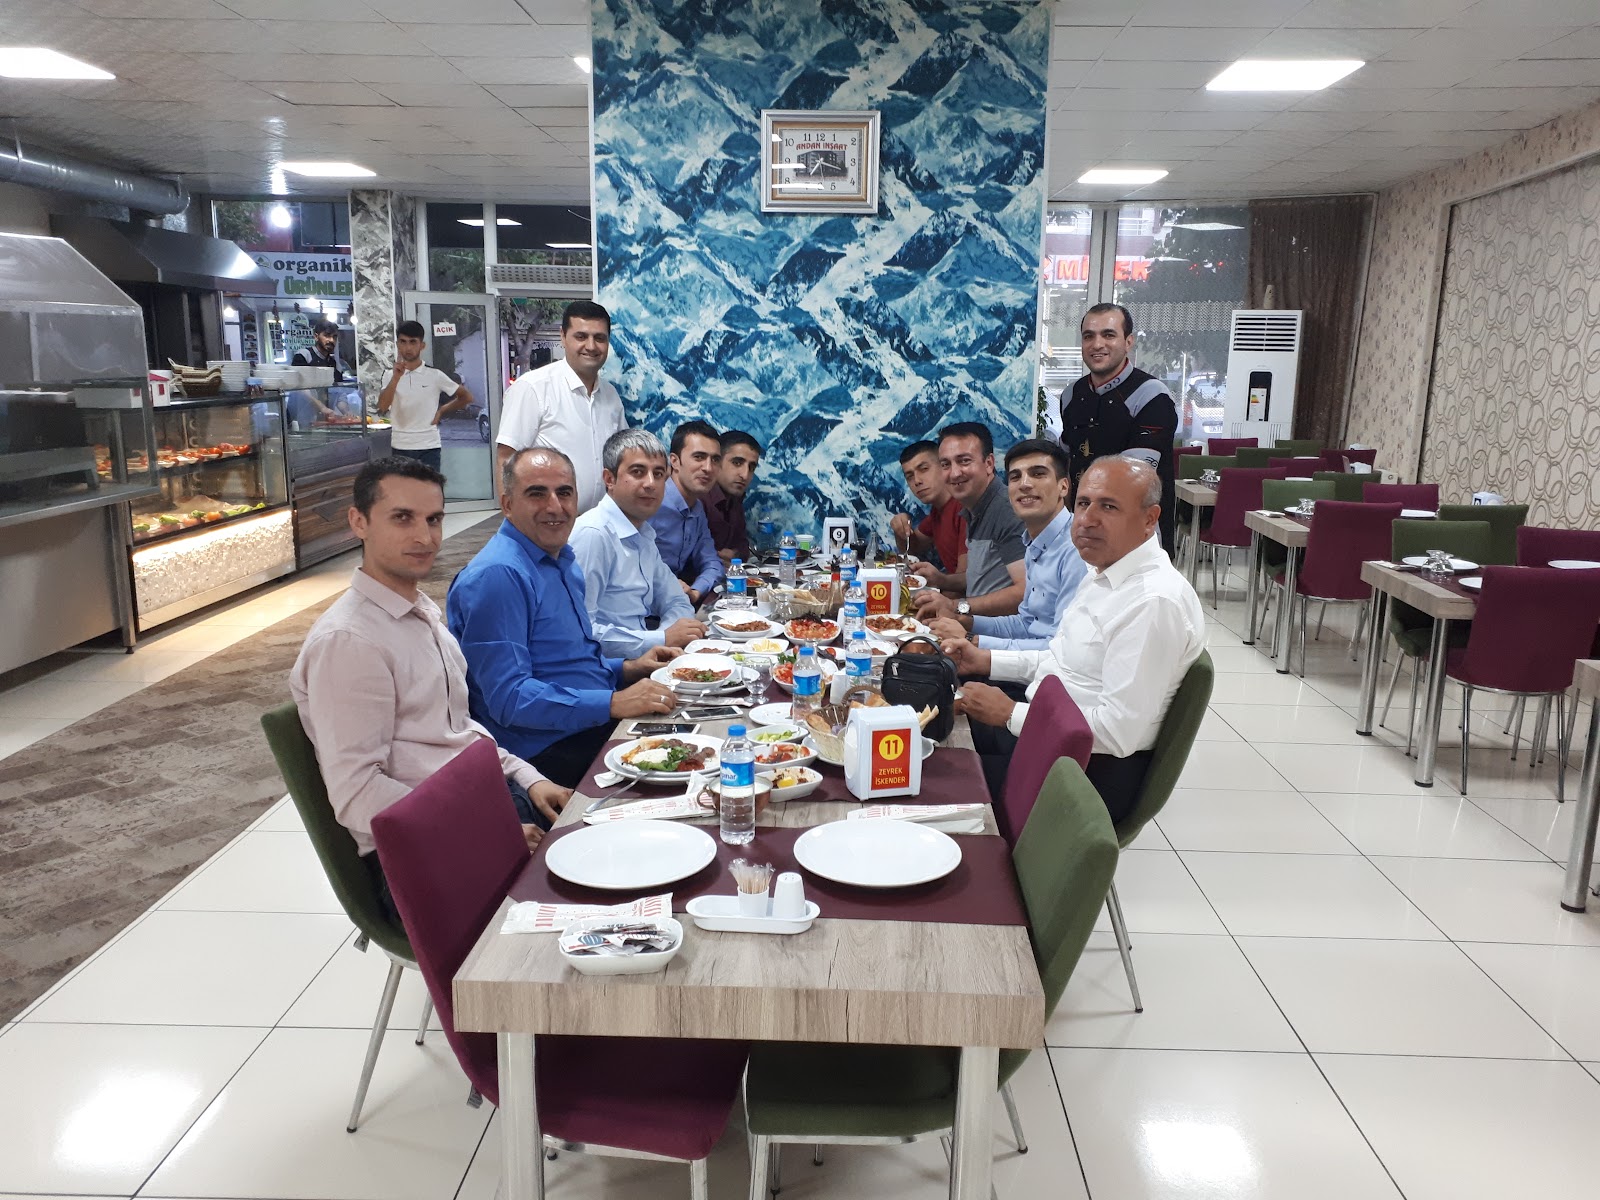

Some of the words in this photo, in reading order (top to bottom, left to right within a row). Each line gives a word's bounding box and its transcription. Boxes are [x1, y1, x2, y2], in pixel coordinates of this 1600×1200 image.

[804, 133, 811, 141] 11
[816, 133, 825, 141] 12
[785, 138, 794, 146] 10
[850, 137, 856, 146] 2
[796, 142, 820, 150] ANDAN
[850, 158, 856, 166] 3
[830, 182, 836, 190] 5
[850, 178, 856, 186] 4
[273, 258, 352, 275] organik
[280, 329, 312, 337] organi
[873, 587, 885, 597] 10
[884, 740, 898, 755] 11
[878, 768, 902, 776] ZEYREK
[875, 776, 906, 786] İSKENDER
